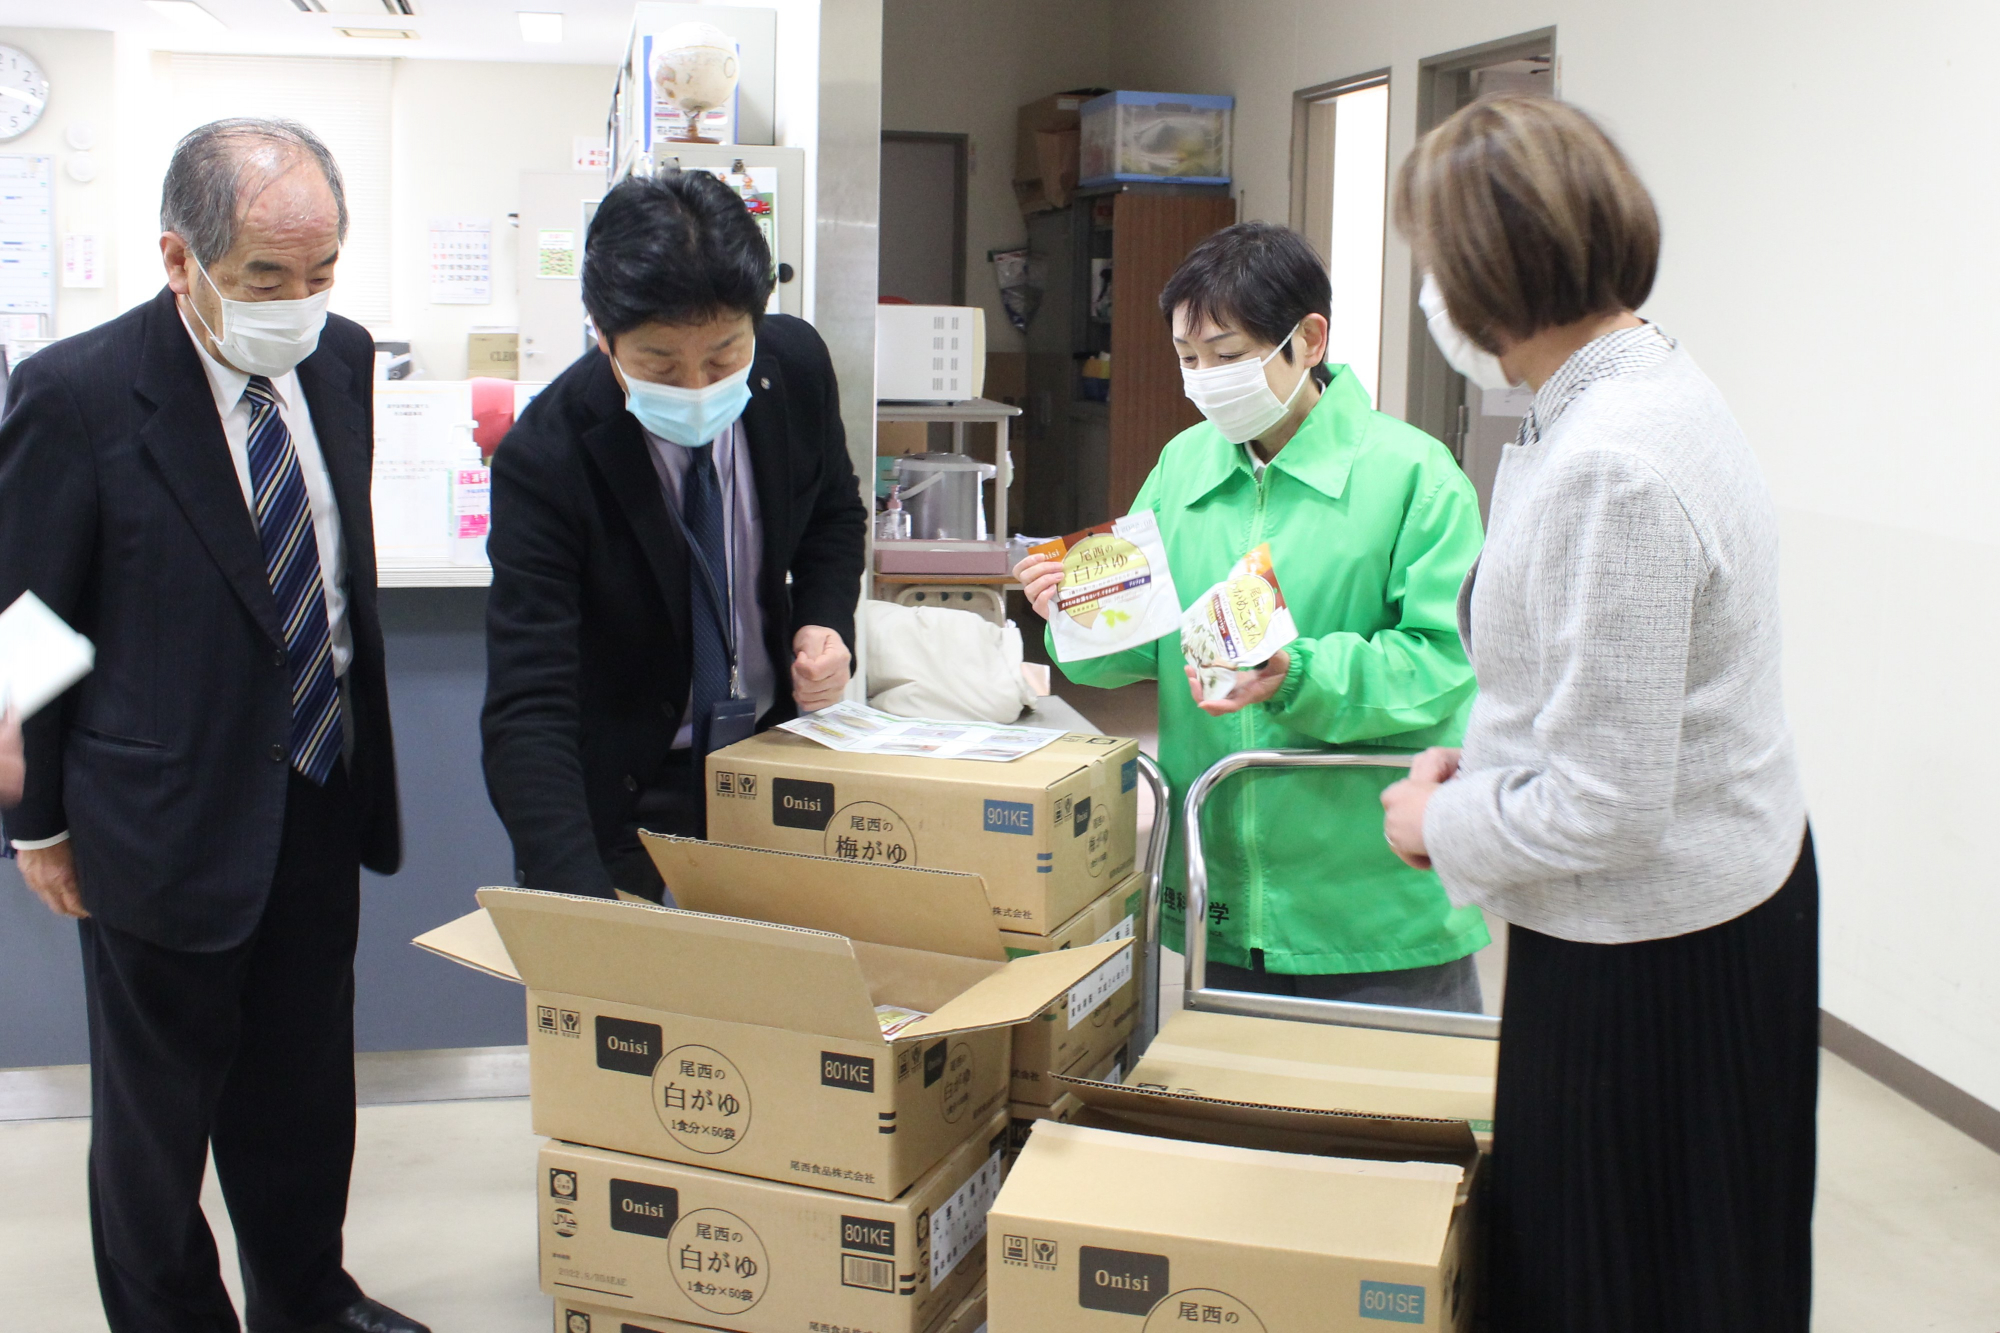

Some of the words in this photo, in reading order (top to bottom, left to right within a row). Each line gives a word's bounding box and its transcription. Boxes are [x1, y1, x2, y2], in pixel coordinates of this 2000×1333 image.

[11, 58, 17, 69] 1
[23, 70, 31, 82] 2
[22, 104, 32, 114] 4
[10, 115, 18, 128] 5
[1079, 544, 1114, 563] 尾西の
[1073, 554, 1128, 584] 白がゆ
[783, 795, 822, 812] Onisi
[850, 815, 894, 833] 尾西の
[987, 806, 1030, 828] 901KE
[835, 834, 908, 864] 梅がゆ
[992, 905, 1034, 920] 株式会社
[541, 1009, 553, 1018] 10
[607, 1035, 650, 1056] Onisi
[679, 1059, 726, 1080] 尾西の
[824, 1060, 870, 1084] 801KE
[664, 1081, 740, 1117] 白がゆ
[671, 1119, 737, 1141] 1食分×50袋
[789, 1159, 876, 1184] 尾西食品株式会社
[621, 1198, 665, 1219] Onisi
[695, 1222, 743, 1243] 尾西の
[844, 1223, 891, 1247] 801KE
[1008, 1237, 1022, 1247] 10
[680, 1244, 758, 1279] 白がゆ
[1095, 1269, 1150, 1292] Onisi
[687, 1280, 754, 1303] 1食分×50袋
[1363, 1289, 1420, 1314] 601SE
[1178, 1300, 1240, 1325] 尾西の
